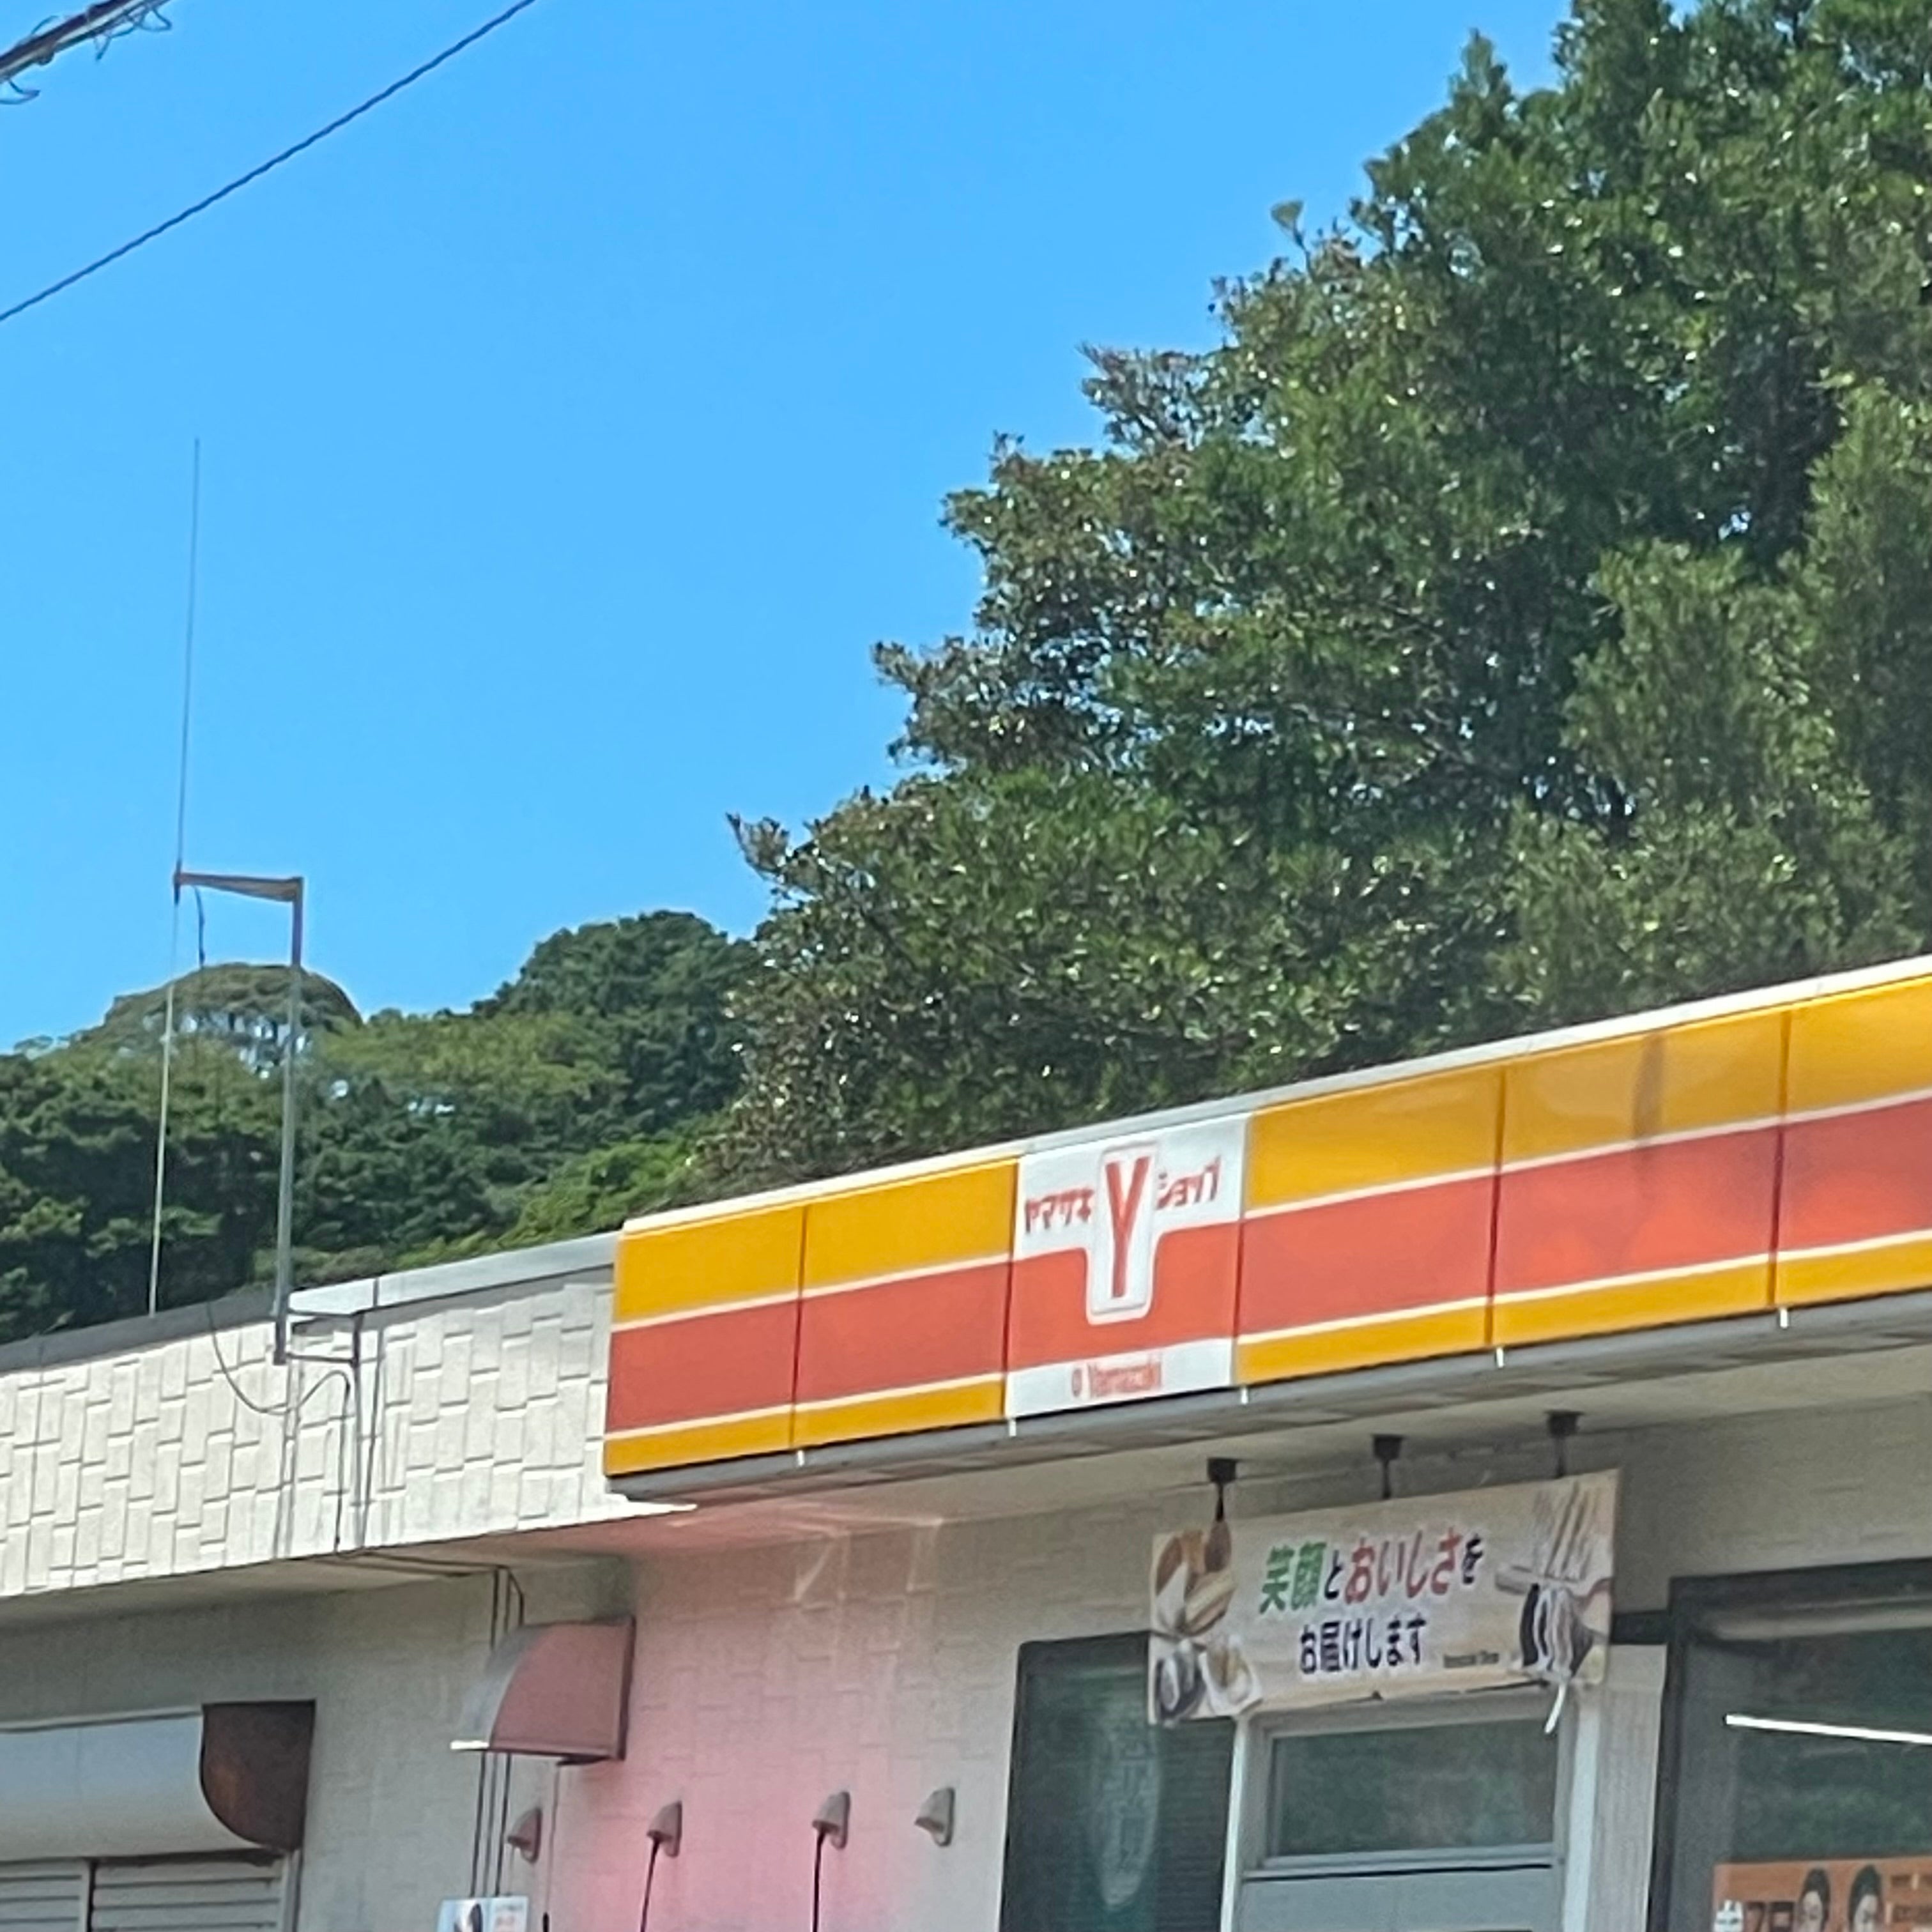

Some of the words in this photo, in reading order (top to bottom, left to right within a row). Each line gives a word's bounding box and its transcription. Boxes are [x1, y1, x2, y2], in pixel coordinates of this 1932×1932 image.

[1105, 1155, 1151, 1299] Y
[1259, 1526, 1483, 1614] 笑顔とおいしさを
[1300, 1613, 1427, 1675] お届けします
